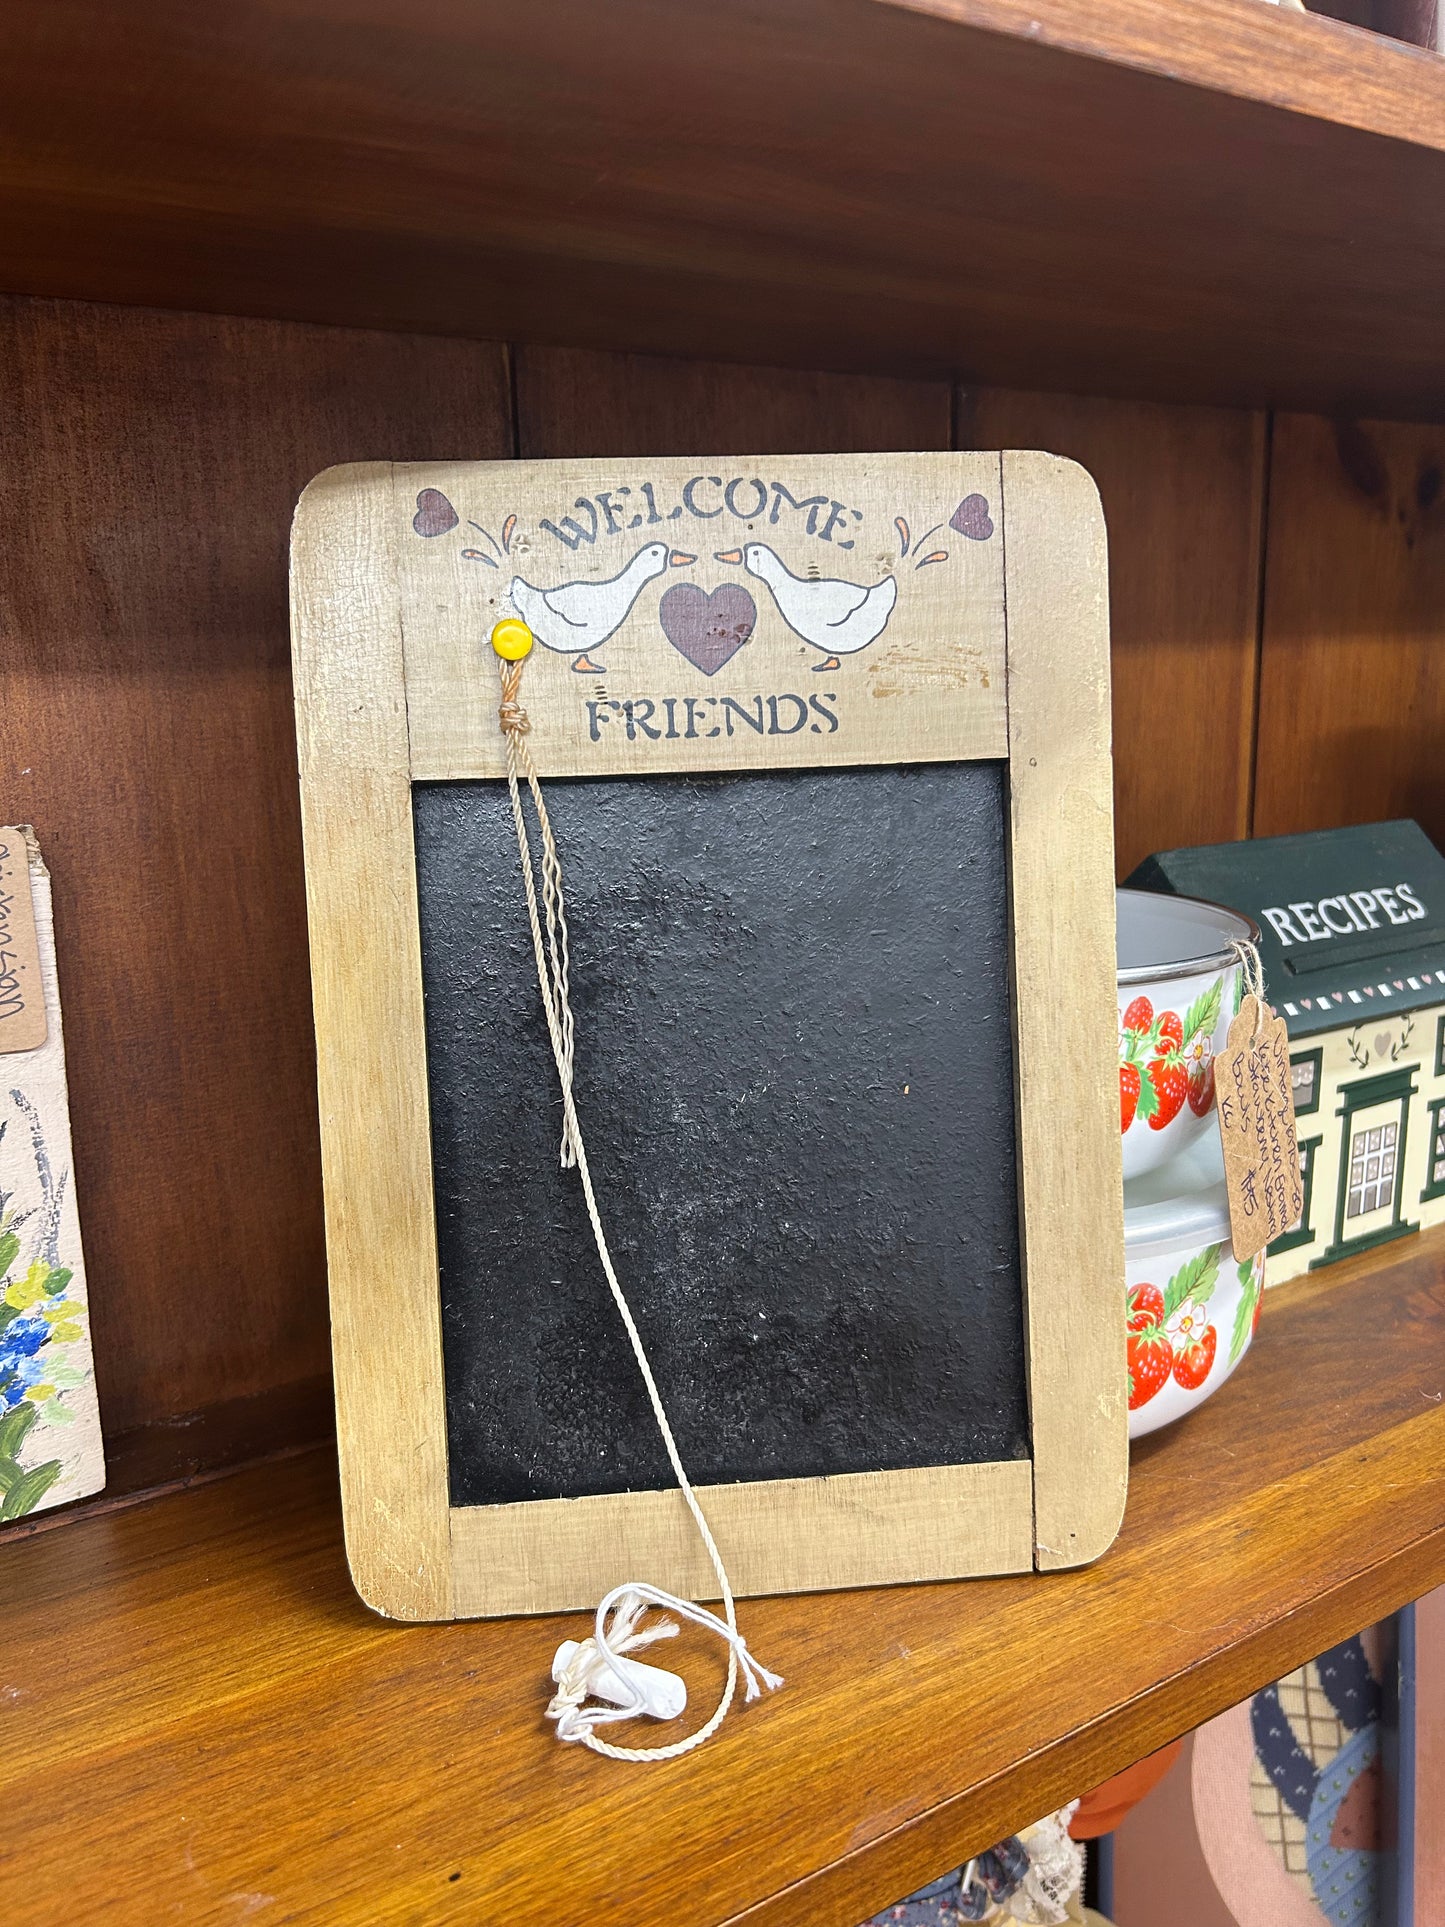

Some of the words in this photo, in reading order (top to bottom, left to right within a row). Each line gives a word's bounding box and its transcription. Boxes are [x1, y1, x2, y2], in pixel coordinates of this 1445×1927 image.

[539, 476, 863, 550] WELCOME
[586, 693, 839, 741] FRIENDS
[1261, 883, 1428, 946] RECIPES
[1232, 1051, 1251, 1133] Bowls
